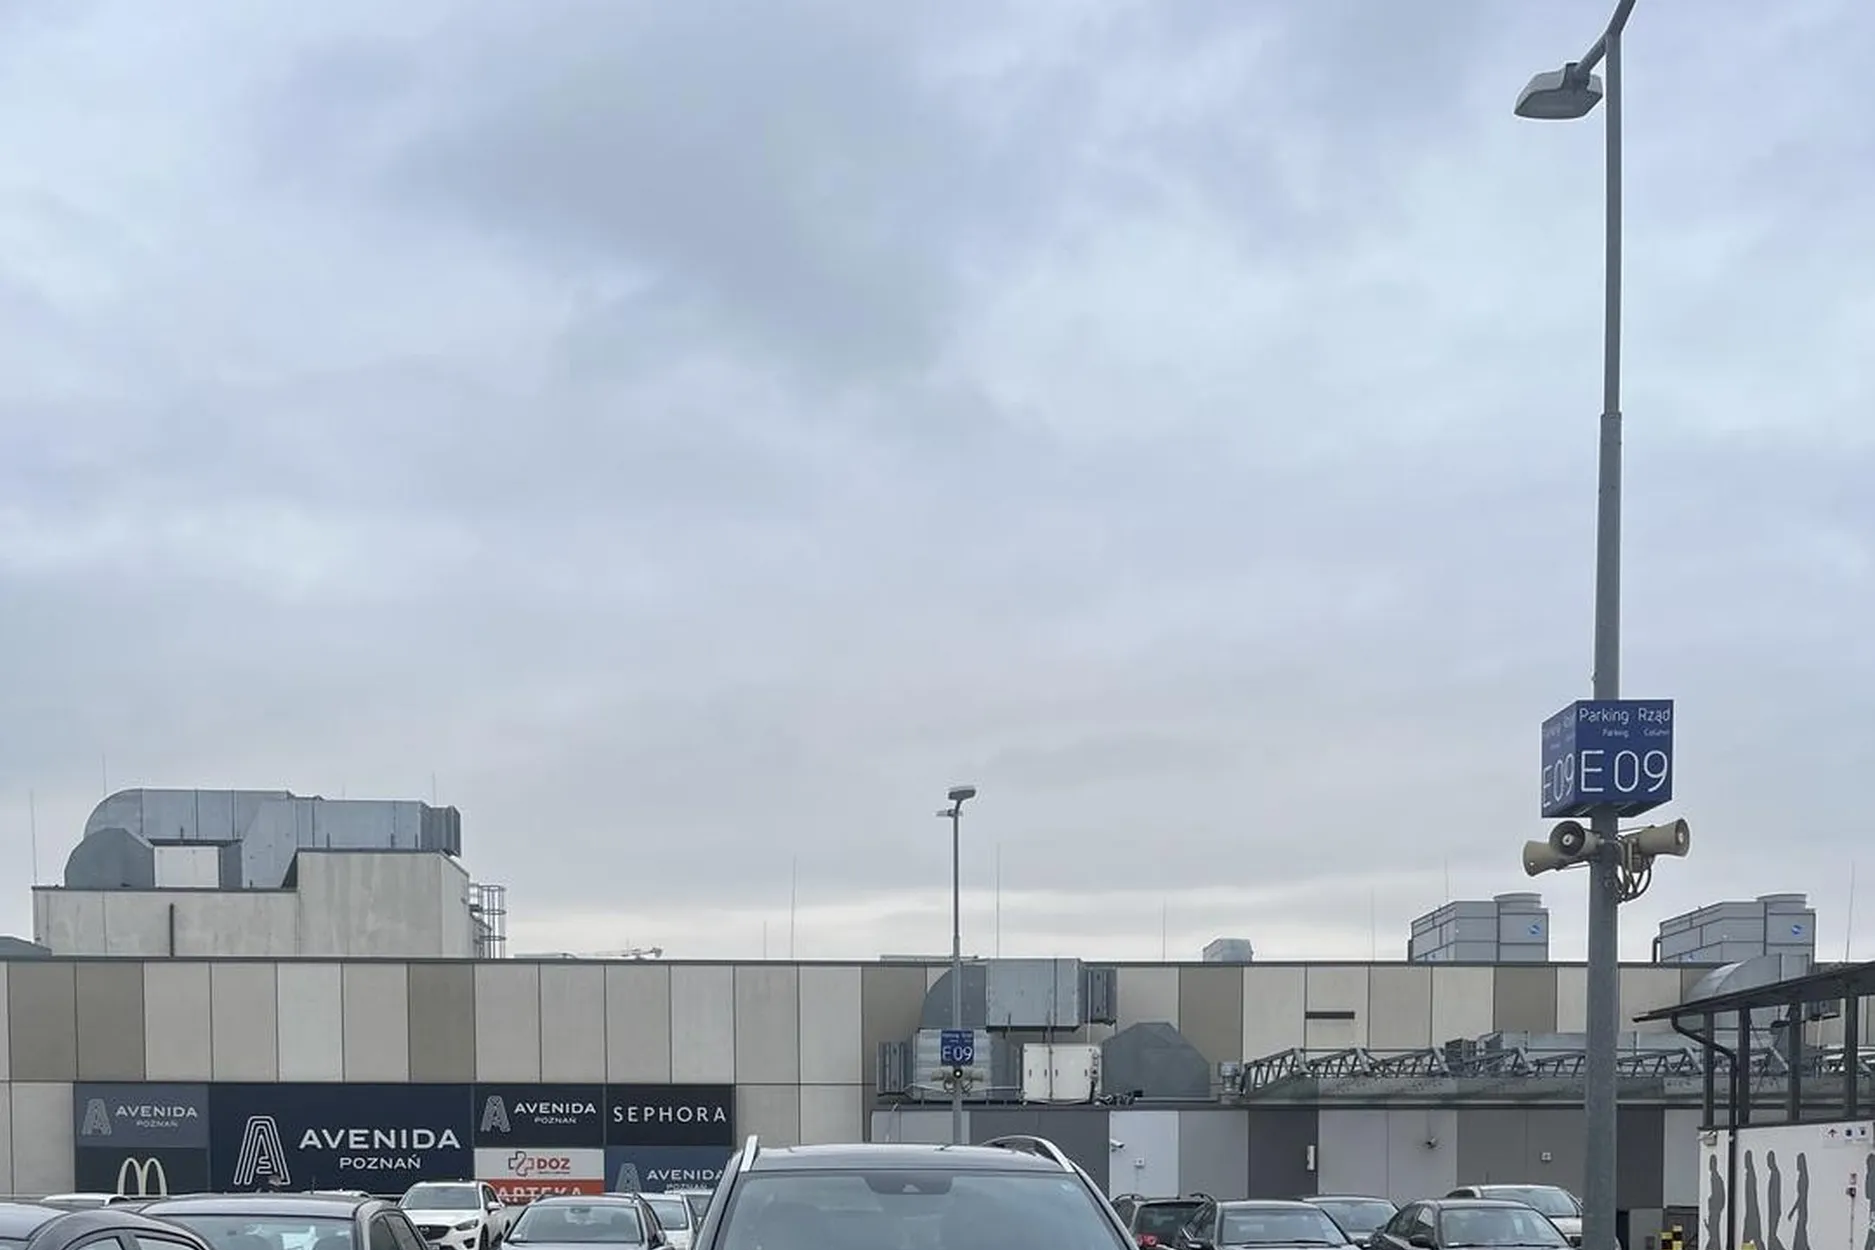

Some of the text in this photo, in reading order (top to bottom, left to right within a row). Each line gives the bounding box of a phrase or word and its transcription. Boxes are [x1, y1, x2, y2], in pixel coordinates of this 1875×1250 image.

[1579, 707, 1671, 725] Parking Rząd
[115, 1106, 198, 1118] AVENIDA
[514, 1103, 597, 1114] AVENIDA
[613, 1106, 727, 1123] SEPHORA
[299, 1128, 461, 1149] AVENIDA
[339, 1154, 421, 1169] POZNAŃ
[536, 1158, 570, 1170] DOZ
